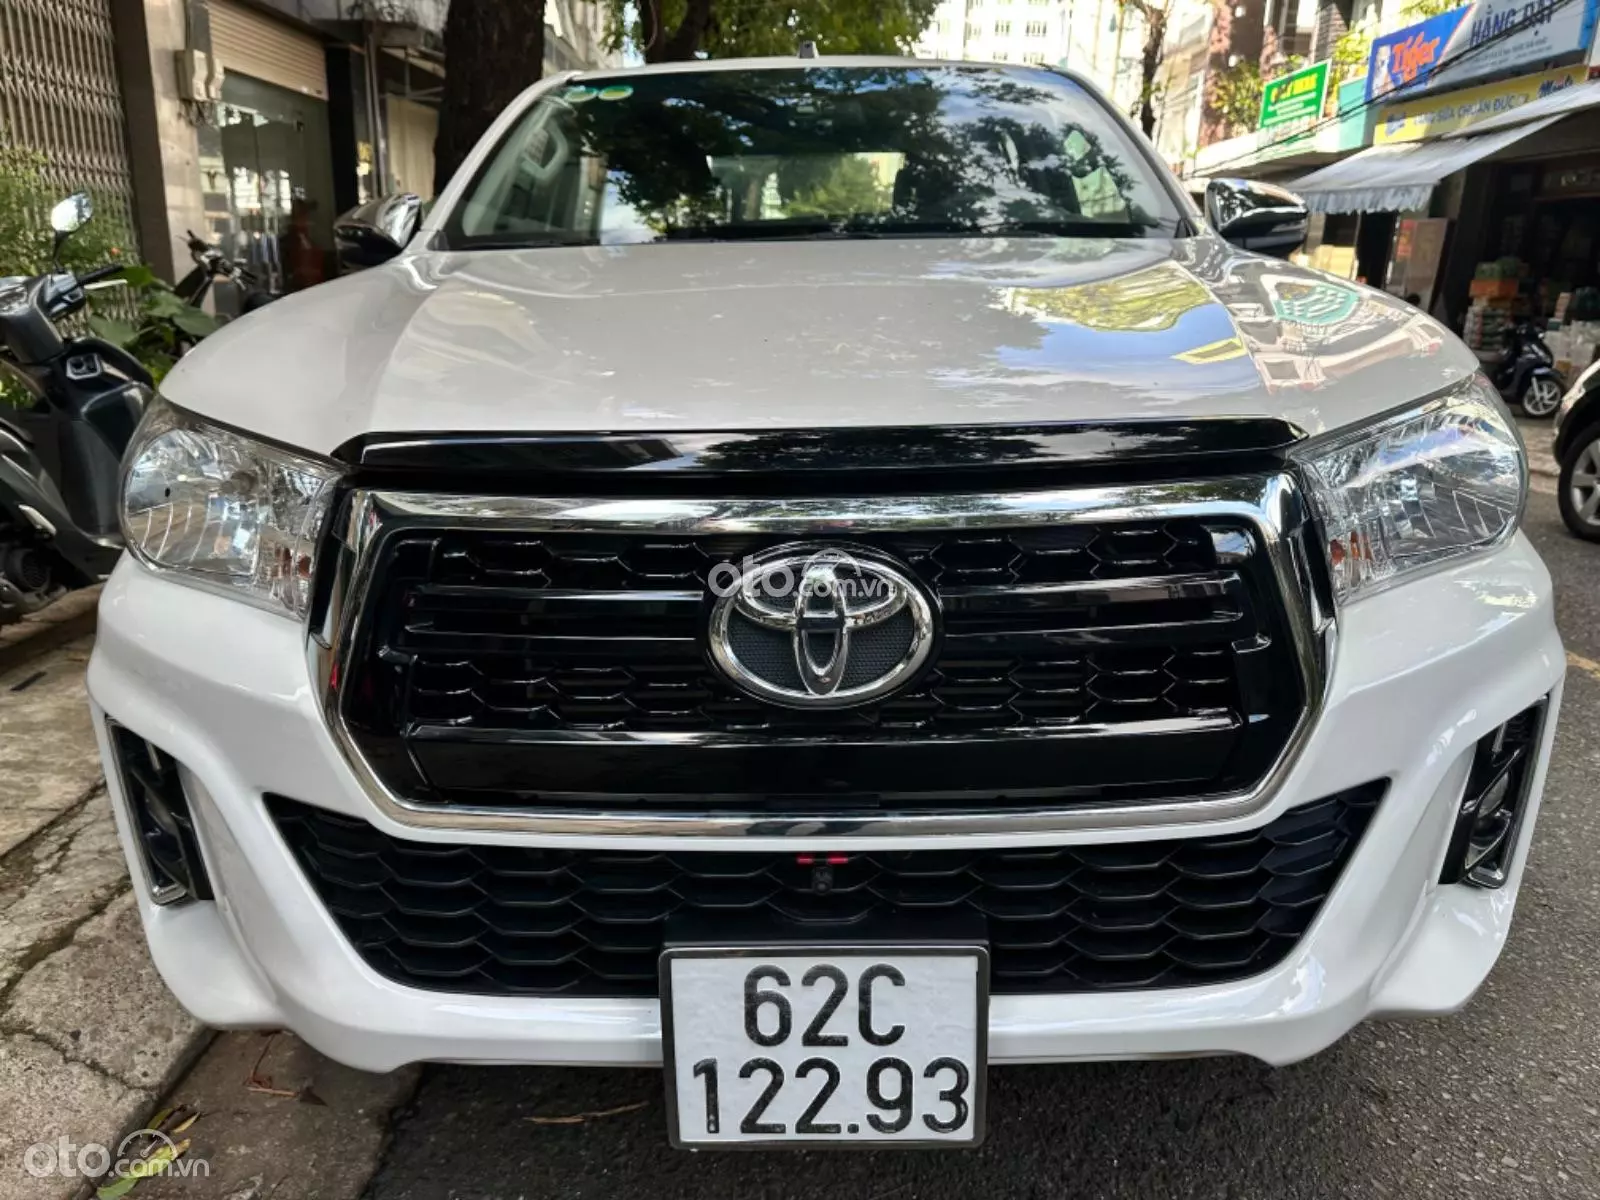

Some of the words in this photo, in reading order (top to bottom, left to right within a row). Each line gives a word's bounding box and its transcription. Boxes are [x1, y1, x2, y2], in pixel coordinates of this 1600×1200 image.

[1392, 31, 1440, 81] Tiger
[744, 963, 906, 1047] 62C
[693, 1056, 969, 1134] 122.93
